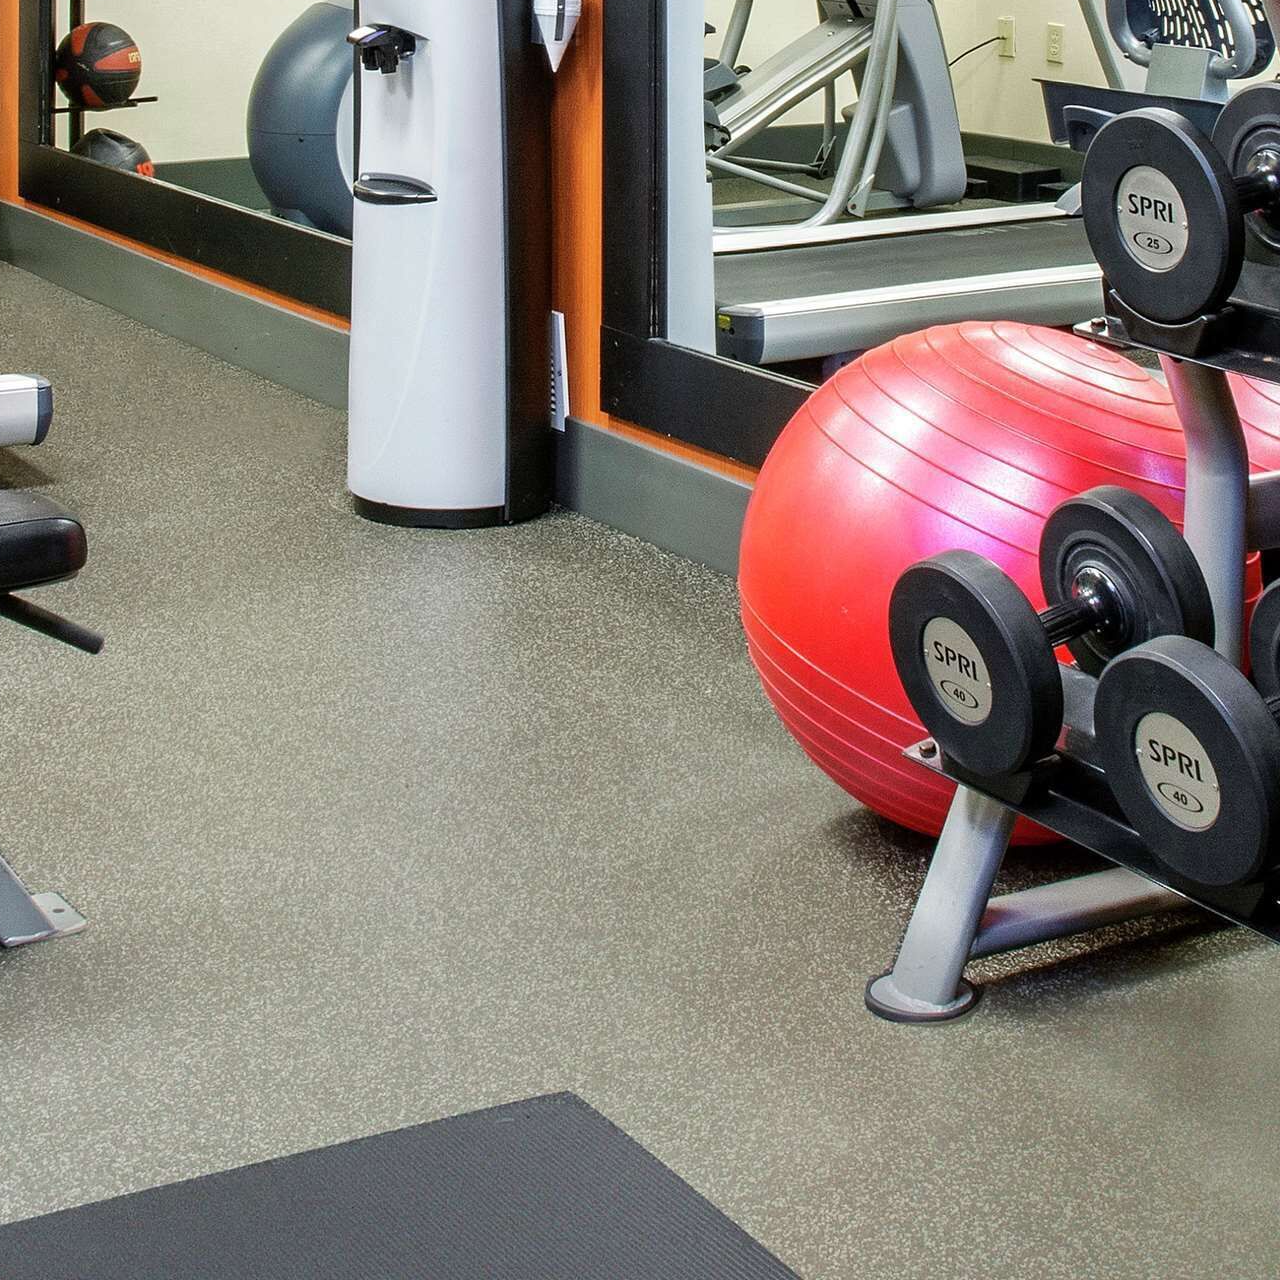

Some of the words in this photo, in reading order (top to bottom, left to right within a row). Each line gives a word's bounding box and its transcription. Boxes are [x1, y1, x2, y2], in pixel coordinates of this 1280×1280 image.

[1128, 193, 1173, 224] SPRI
[1146, 237, 1160, 250] 25
[933, 641, 980, 684] SPRI
[953, 687, 966, 702] 40
[1148, 740, 1204, 783] SPRI
[1172, 790, 1188, 806] 40
